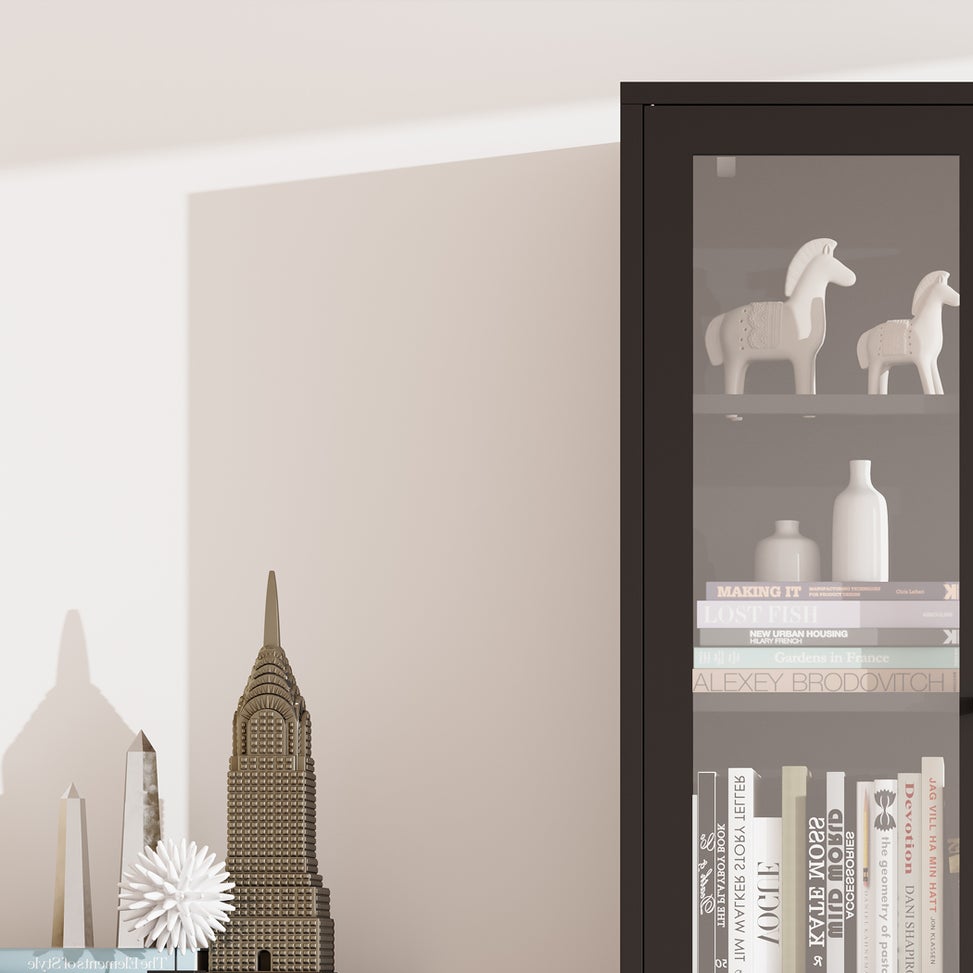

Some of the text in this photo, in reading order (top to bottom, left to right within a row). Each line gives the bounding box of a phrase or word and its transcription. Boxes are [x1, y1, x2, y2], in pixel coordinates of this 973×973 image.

[717, 586, 802, 598] MAKING IT
[704, 605, 817, 624] LOST FISH
[749, 630, 848, 638] NEW URBAN HOUSING
[774, 651, 890, 664] Gardens in France
[694, 672, 785, 692] ALEXEY
[792, 672, 944, 692] BRODOVITCH
[904, 783, 915, 875] Devotion
[881, 836, 891, 856] the
[929, 777, 937, 913] JAG VILL HA MIN HATT
[878, 860, 891, 921] geometry
[904, 884, 915, 919] DANI
[881, 925, 891, 939] of
